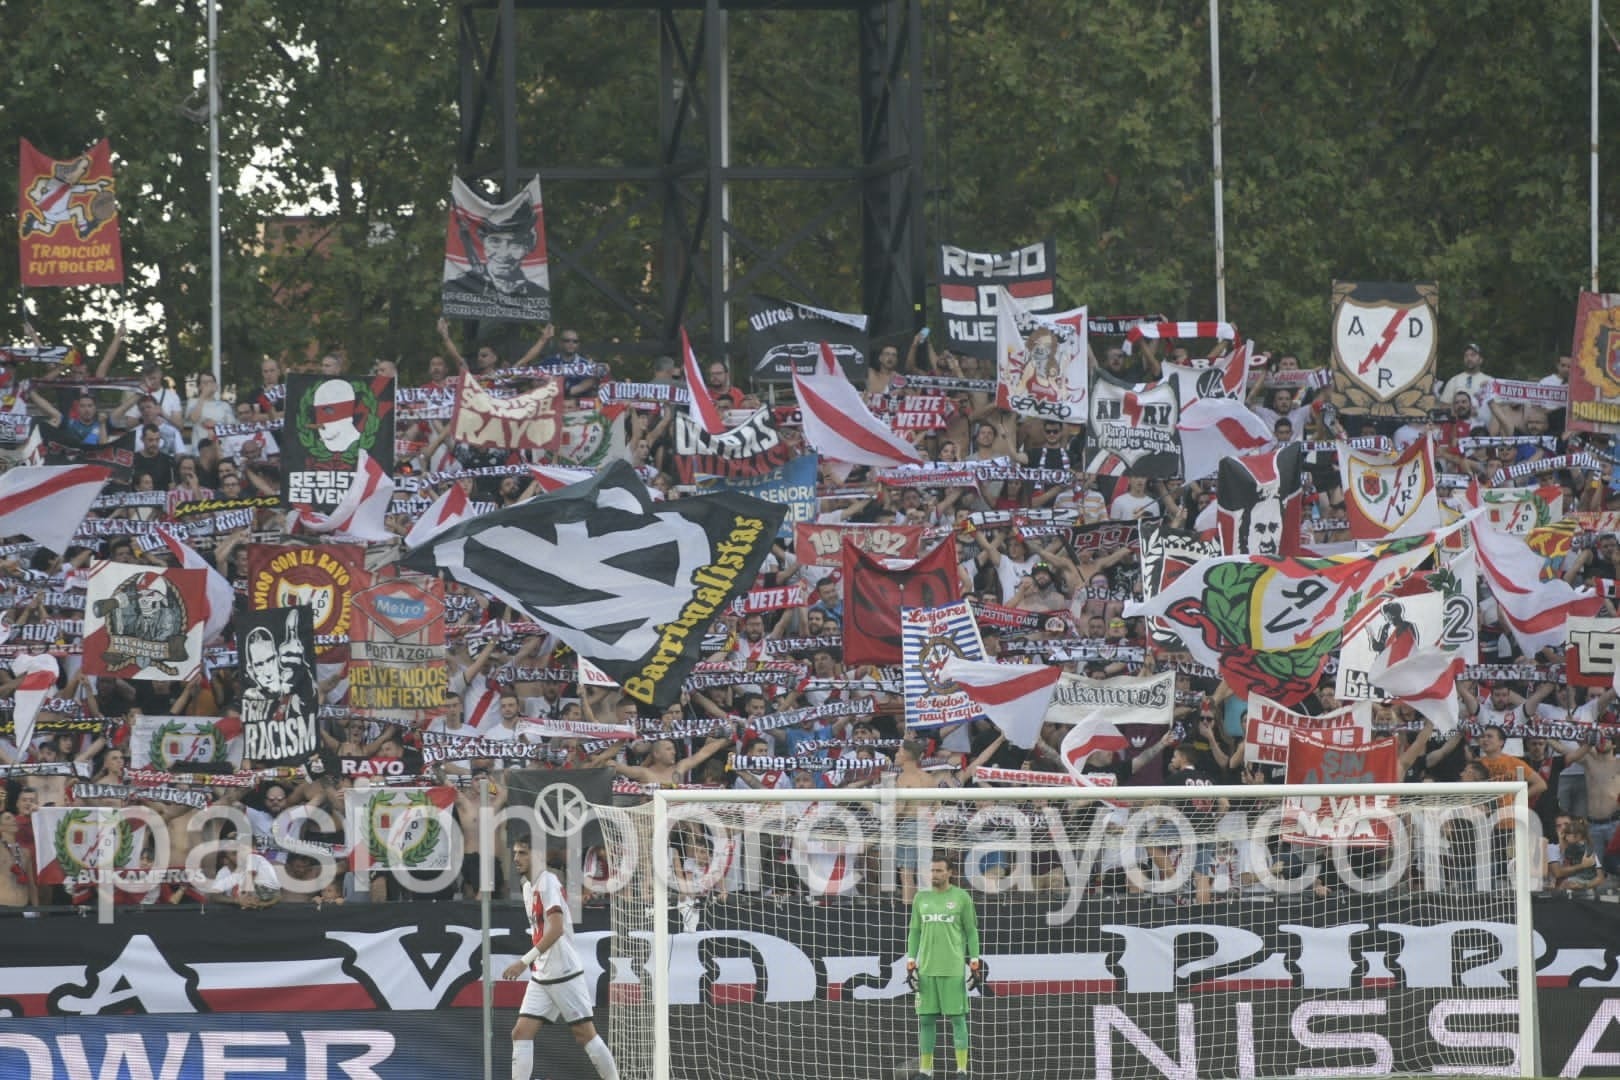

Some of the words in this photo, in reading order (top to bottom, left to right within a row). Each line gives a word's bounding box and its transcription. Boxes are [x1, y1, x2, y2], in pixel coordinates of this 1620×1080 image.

[31, 240, 112, 258] TRADICIÓN
[29, 258, 116, 275] FUTBOLERA
[942, 243, 1046, 277] RAYO
[1347, 316, 1365, 337] A
[1409, 317, 1424, 338] D
[1377, 367, 1395, 388] R
[904, 396, 942, 411] VETE
[896, 411, 934, 428] VETE
[289, 488, 308, 504] ES
[807, 530, 842, 556] 19
[871, 528, 908, 557] 92
[271, 551, 299, 575] CON
[316, 552, 350, 587] RAYO
[376, 600, 421, 615] Metro
[750, 590, 788, 609] VETE
[366, 645, 433, 660] PORTAZGO
[1346, 683, 1378, 698] DEL
[243, 712, 316, 762] RACISM
[341, 758, 404, 776] RAYO
[921, 912, 953, 924] DIGI
